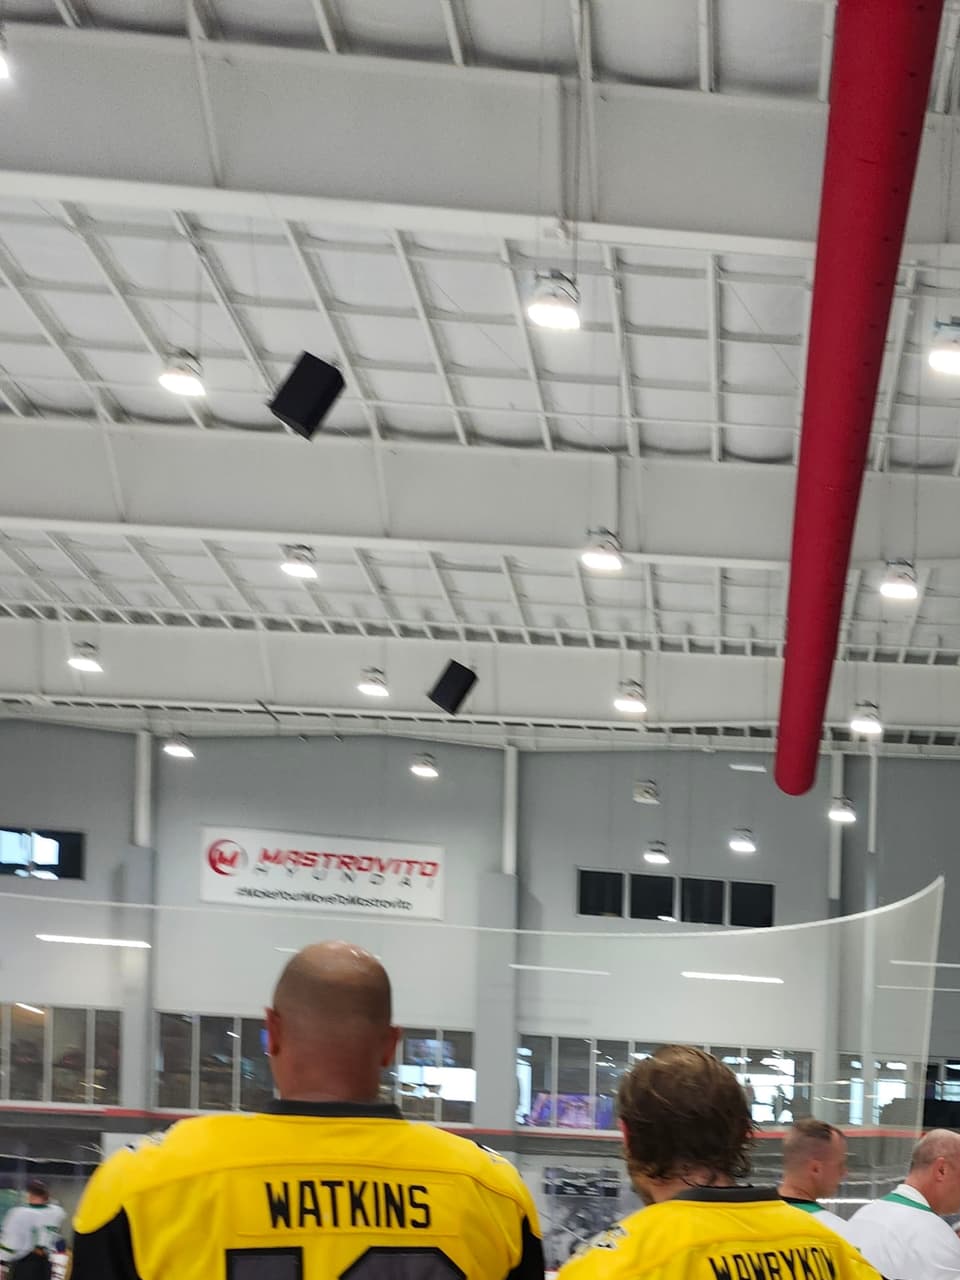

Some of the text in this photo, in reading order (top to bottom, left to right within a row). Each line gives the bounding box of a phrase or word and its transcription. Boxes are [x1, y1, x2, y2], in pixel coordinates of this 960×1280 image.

[255, 864, 434, 888] HYUNDAI
[258, 847, 439, 878] MASTROVITO
[265, 1180, 431, 1229] WATKINS
